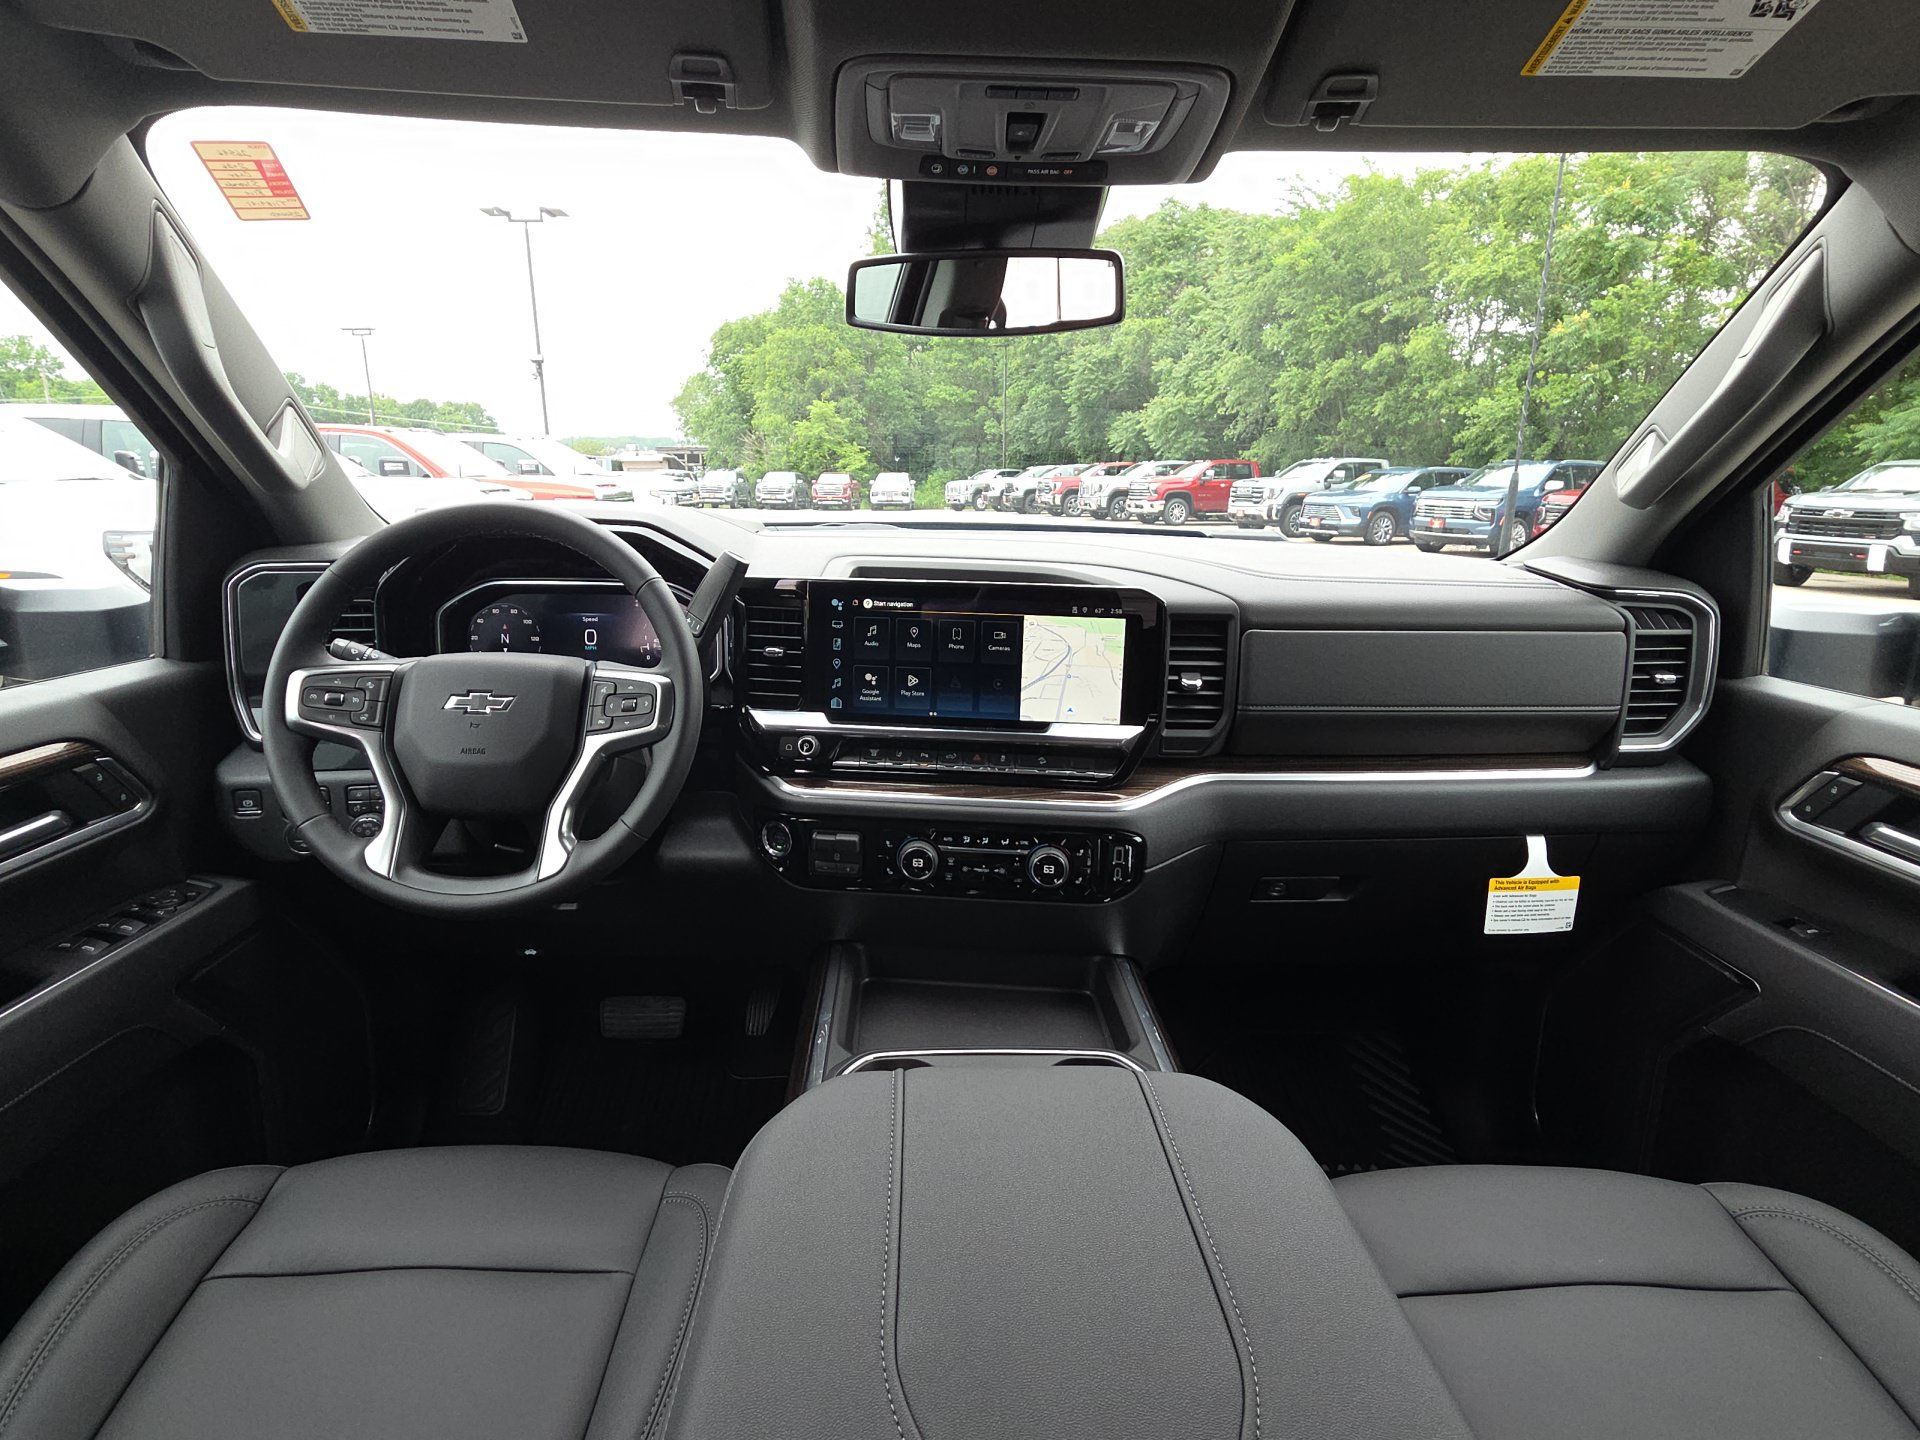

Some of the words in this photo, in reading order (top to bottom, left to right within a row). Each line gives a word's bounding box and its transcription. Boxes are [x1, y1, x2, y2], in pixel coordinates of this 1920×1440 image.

[1614, 28, 1631, 36] DES
[887, 601, 914, 609] navigation
[500, 633, 510, 644] N
[906, 641, 922, 649] Maps
[861, 688, 880, 696] Google
[900, 689, 911, 697] Play
[460, 747, 486, 755] AIRBAG
[1043, 865, 1055, 874] 63
